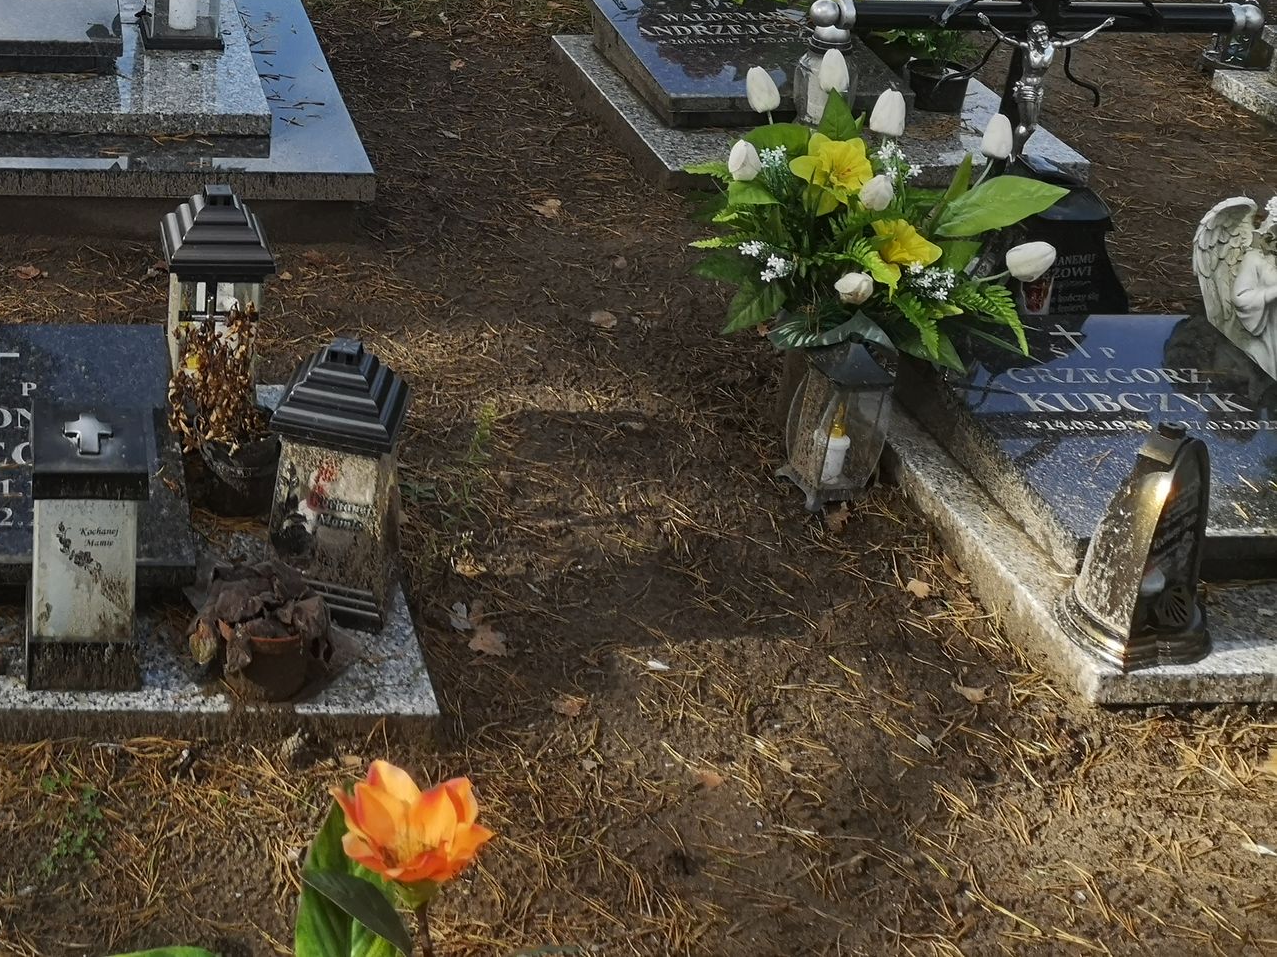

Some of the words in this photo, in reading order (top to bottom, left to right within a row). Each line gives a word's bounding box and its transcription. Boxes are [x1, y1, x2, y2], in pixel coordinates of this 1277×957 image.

[658, 11, 787, 22] WALDEMAR
[1099, 346, 1116, 359] P
[1006, 367, 1212, 384] GRZEGORZ
[20, 382, 37, 396] P
[1016, 392, 1253, 413] KUBCZYK
[79, 526, 119, 537] Kochanej
